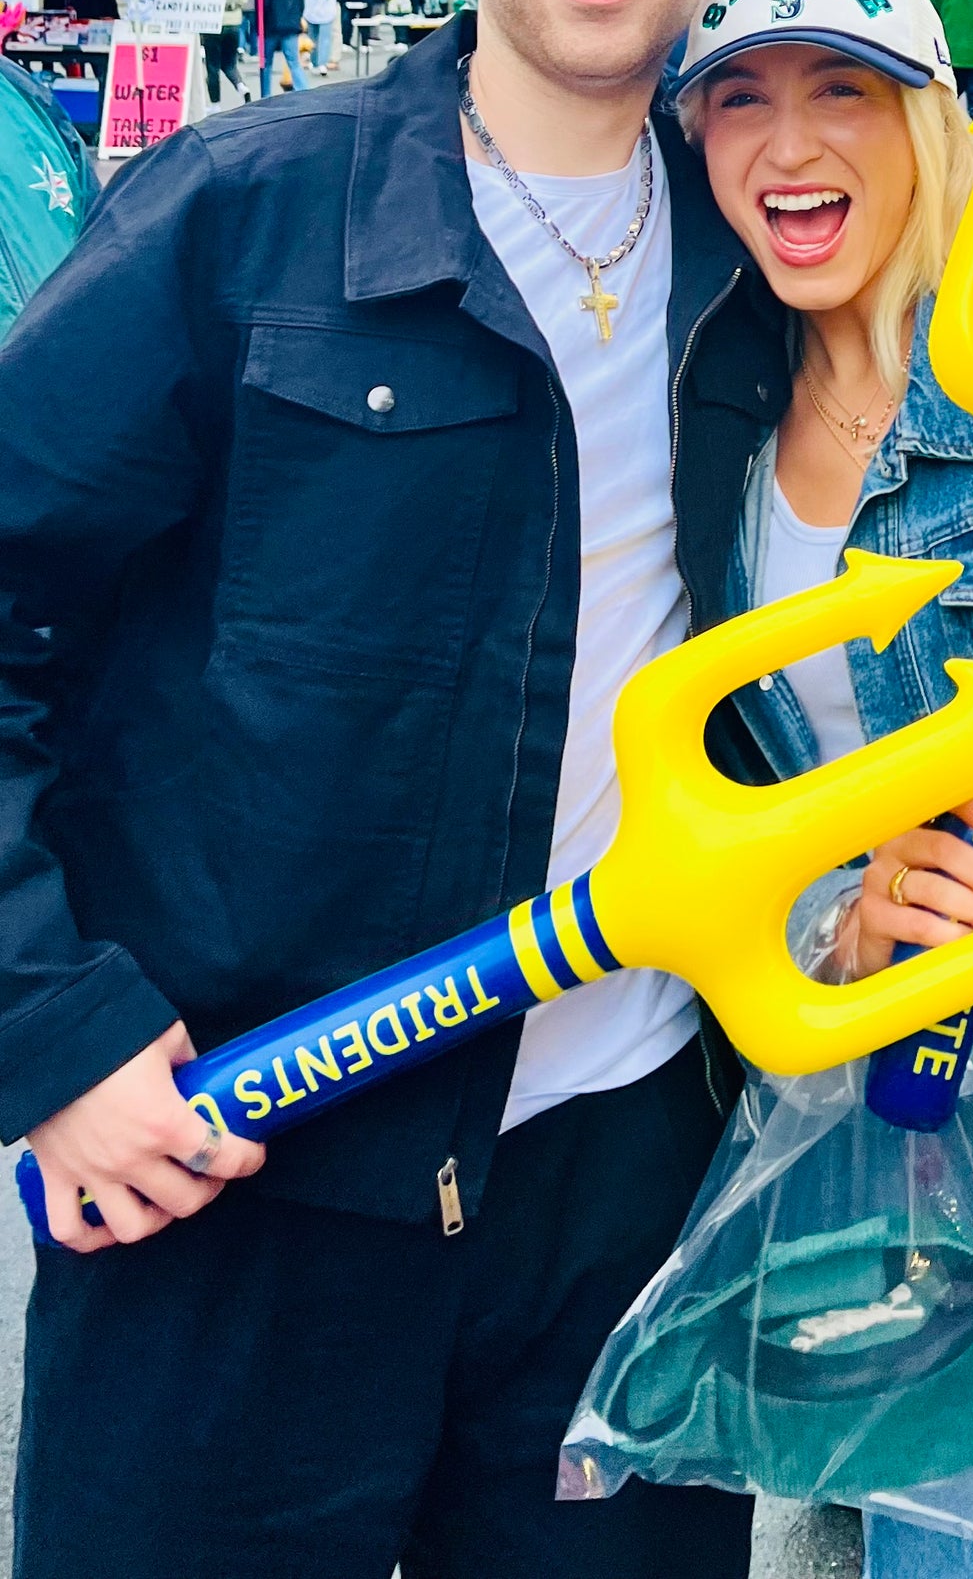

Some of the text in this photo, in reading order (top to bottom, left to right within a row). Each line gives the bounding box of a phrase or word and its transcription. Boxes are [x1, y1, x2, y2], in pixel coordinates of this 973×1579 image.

[142, 46, 159, 63] $1
[114, 85, 180, 102] WATER
[159, 119, 177, 133] IT
[233, 965, 500, 1120] TRIDENTS
